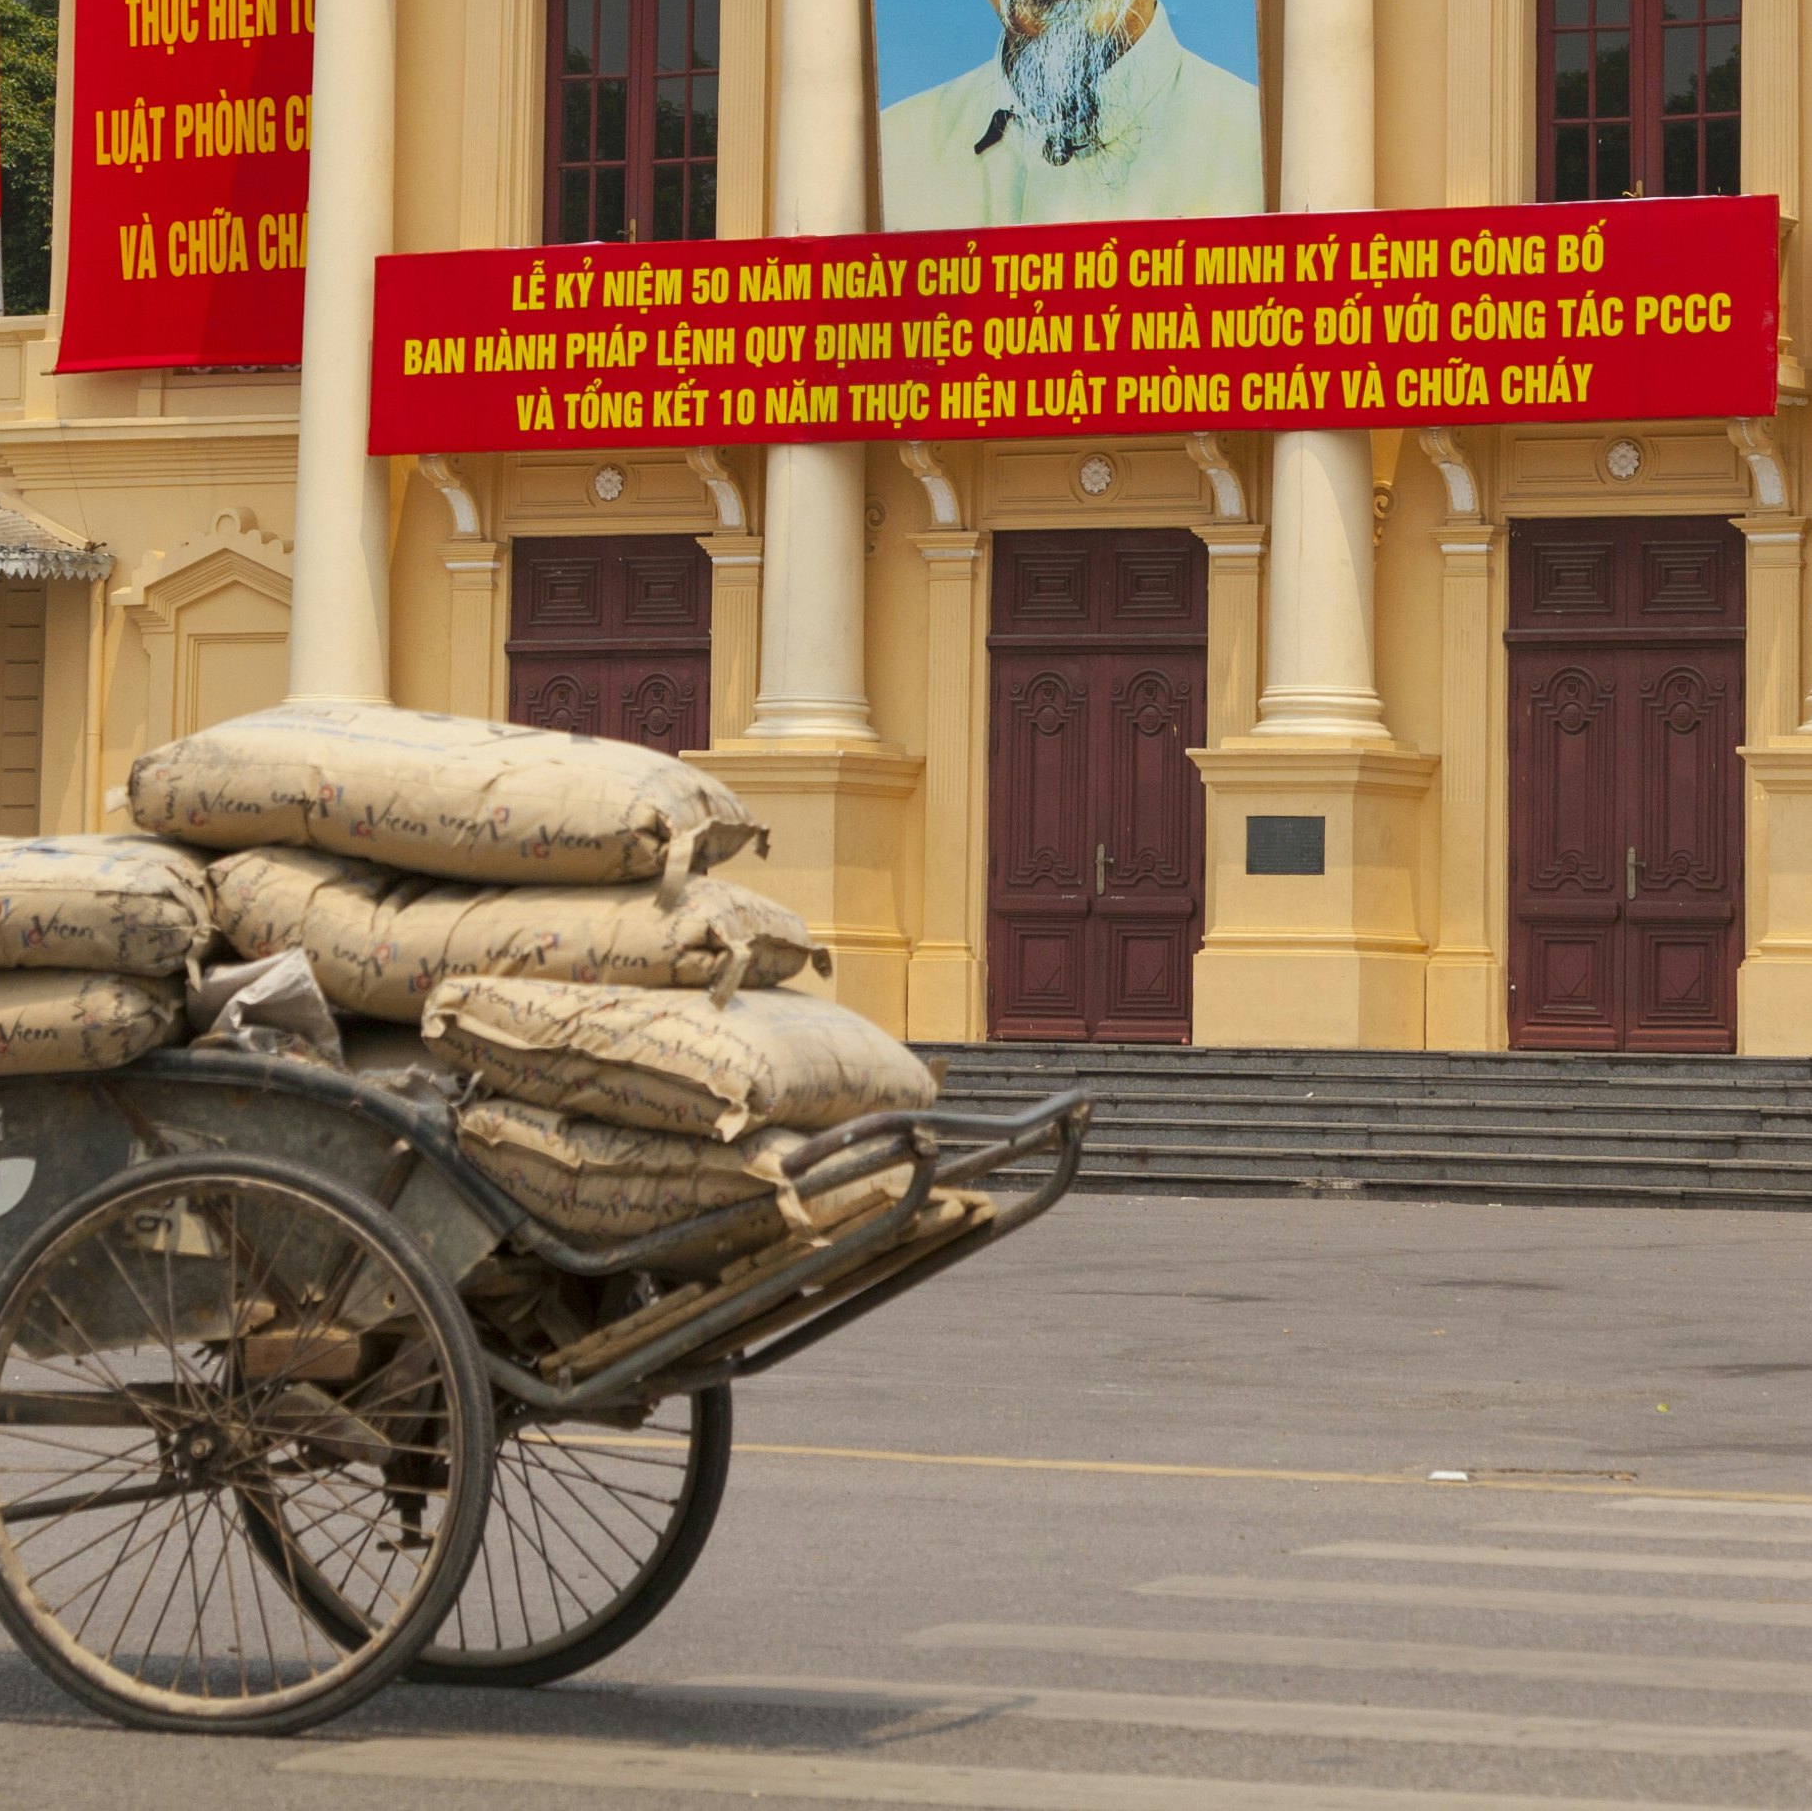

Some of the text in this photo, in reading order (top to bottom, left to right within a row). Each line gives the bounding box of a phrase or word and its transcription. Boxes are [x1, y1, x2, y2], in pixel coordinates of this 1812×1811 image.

[95, 97, 165, 173] LUẬT
[175, 89, 276, 159] PHÒNG
[119, 212, 157, 281] VÀ
[168, 207, 249, 277] CHỮA
[512, 219, 1606, 315] LỄ KỶ NIỆM 50 NĂM NGÀY CHỦ TỊCH HỒ CHÍ MINH KÝ LỆNH CÔNG BỐ
[403, 289, 1732, 376] BAN HÀNH PHÁP LỆNH QUY ĐỊNH VIỆC QUẢN LÝ NHÀ NƯỚC ĐỐI VỚI CÔNG TÁC PCCC
[516, 355, 1594, 431] VÀ TỔNG KẾT 10 NĂM THỰC HIỆN LUẬT PHÒNG CHÁY VÀ CHỮA CHÁY
